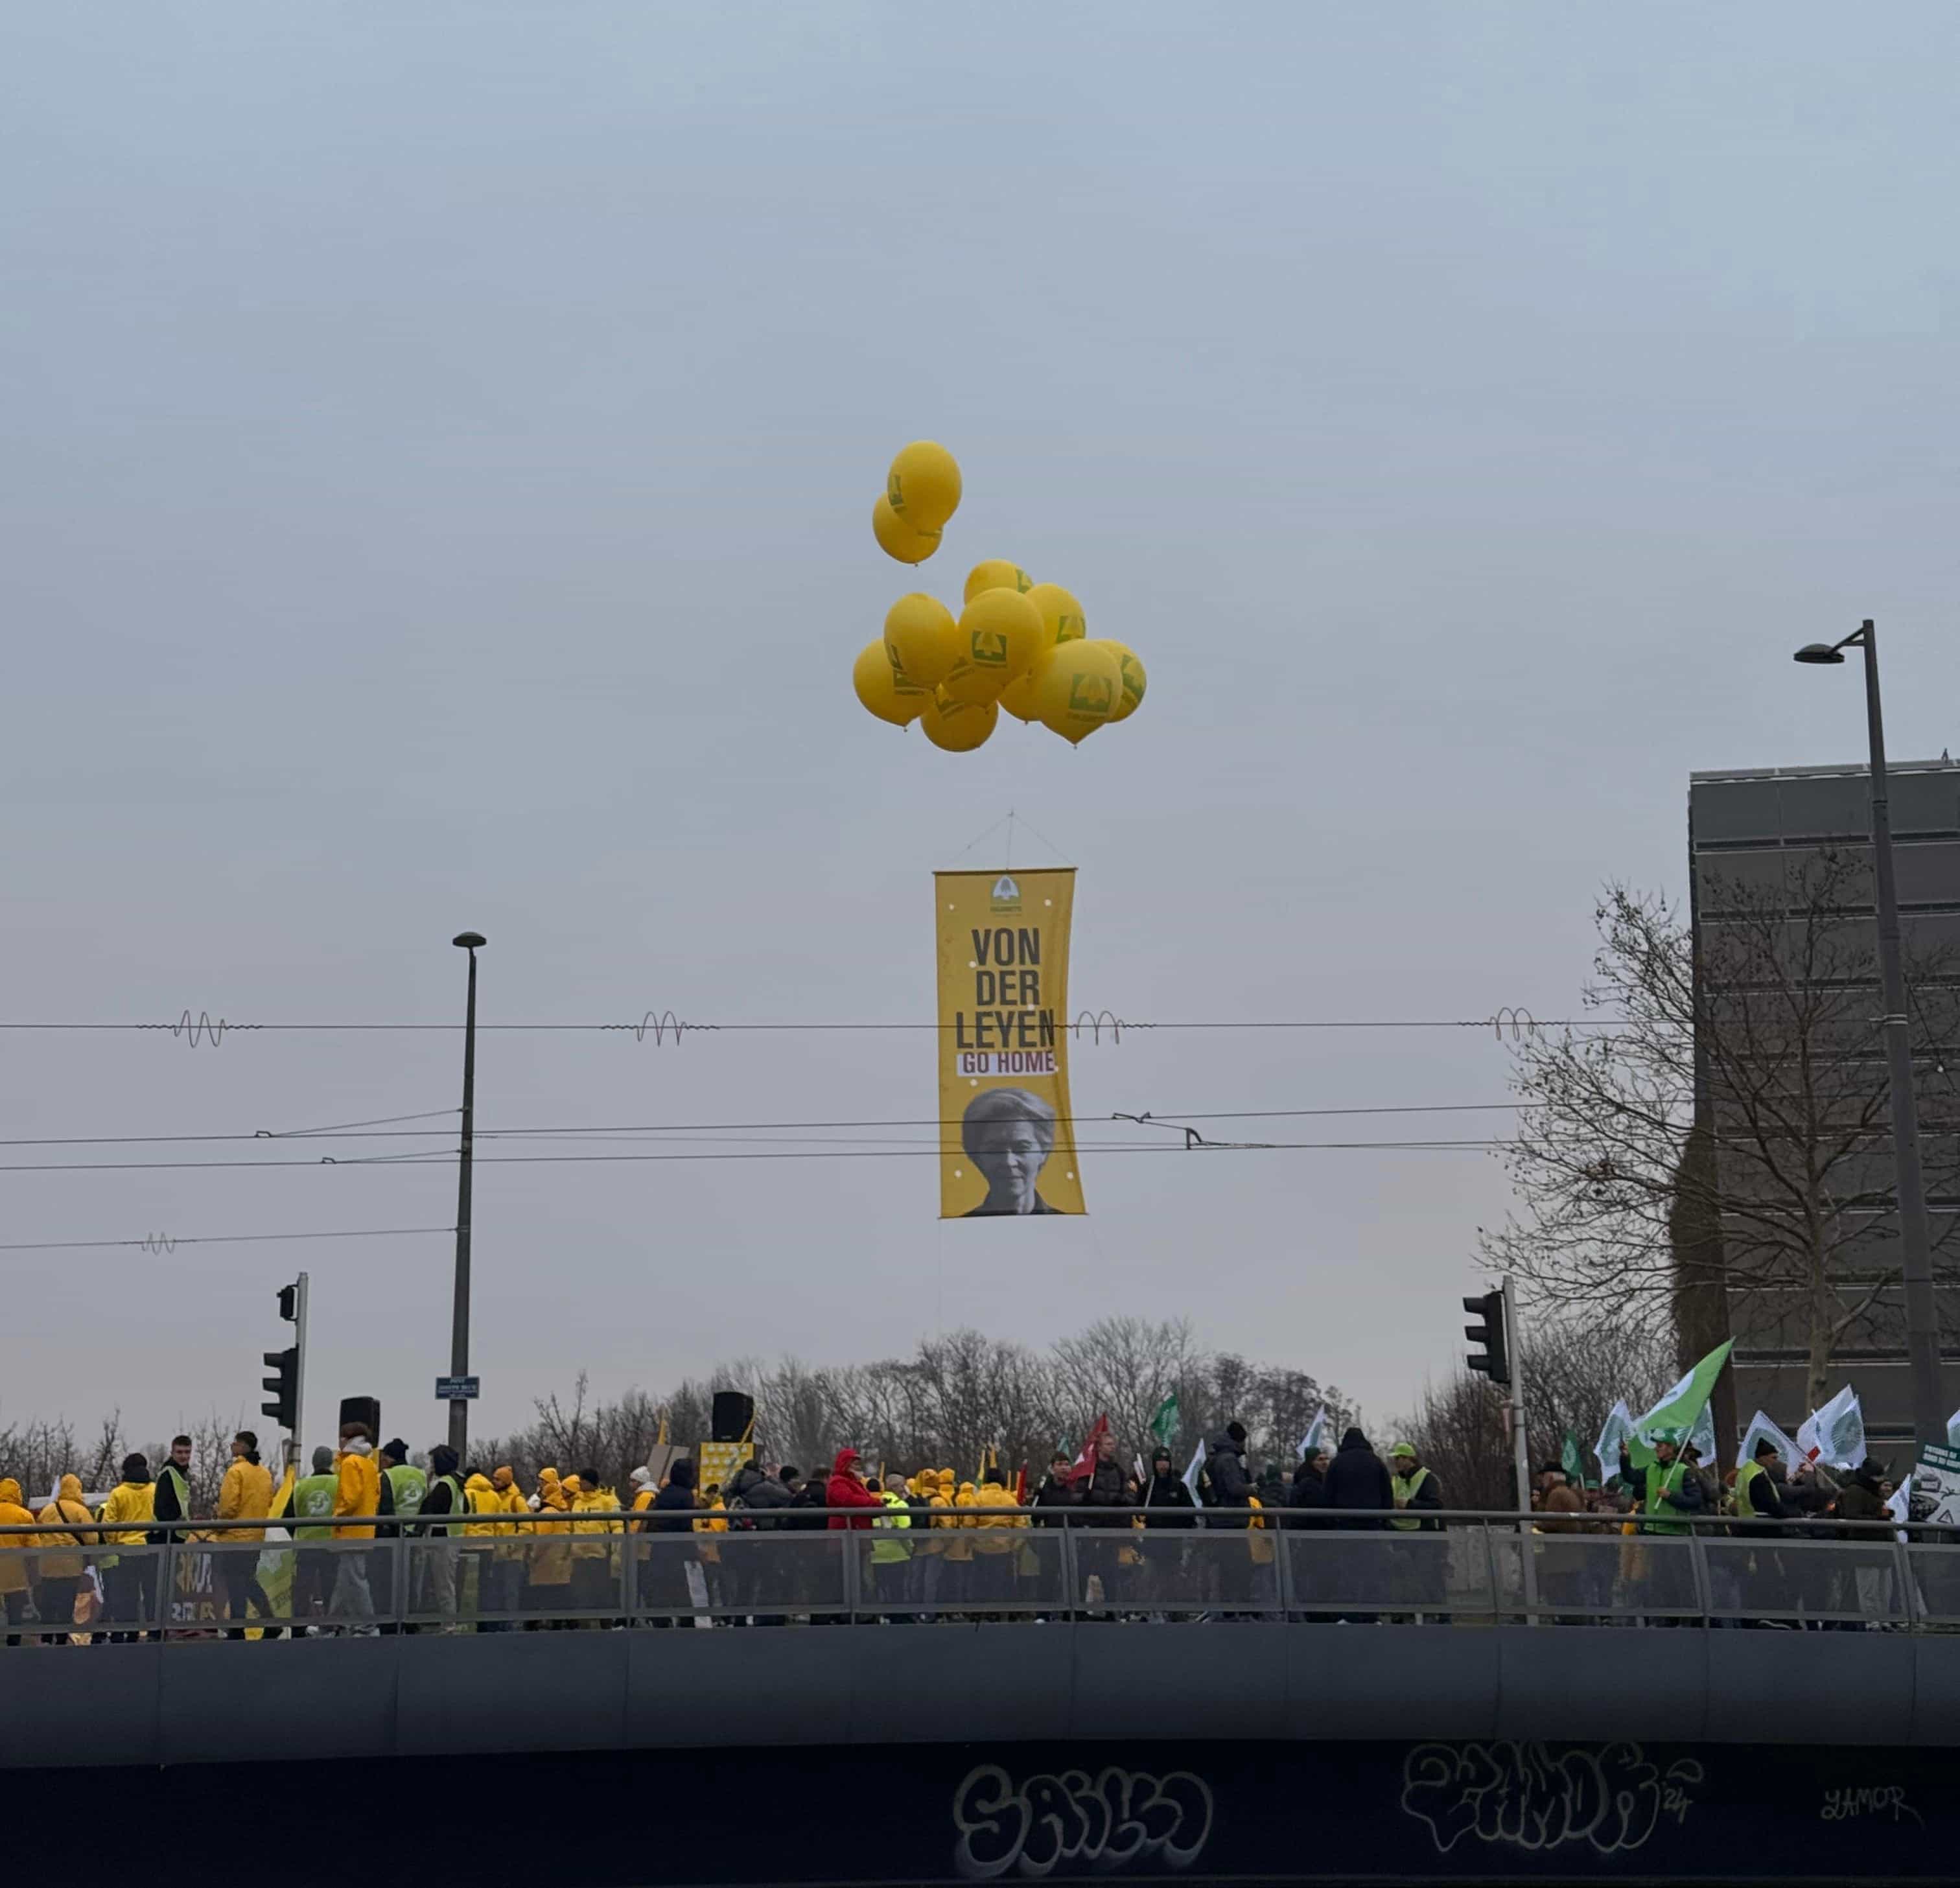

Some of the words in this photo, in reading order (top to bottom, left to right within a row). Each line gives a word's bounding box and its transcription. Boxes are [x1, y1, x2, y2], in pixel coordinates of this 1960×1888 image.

[971, 927, 1040, 966] VON
[976, 970, 1040, 1007] DER
[956, 1008, 1055, 1049] LEYEN
[962, 1051, 990, 1074] GO
[998, 1050, 1055, 1074] HOME
